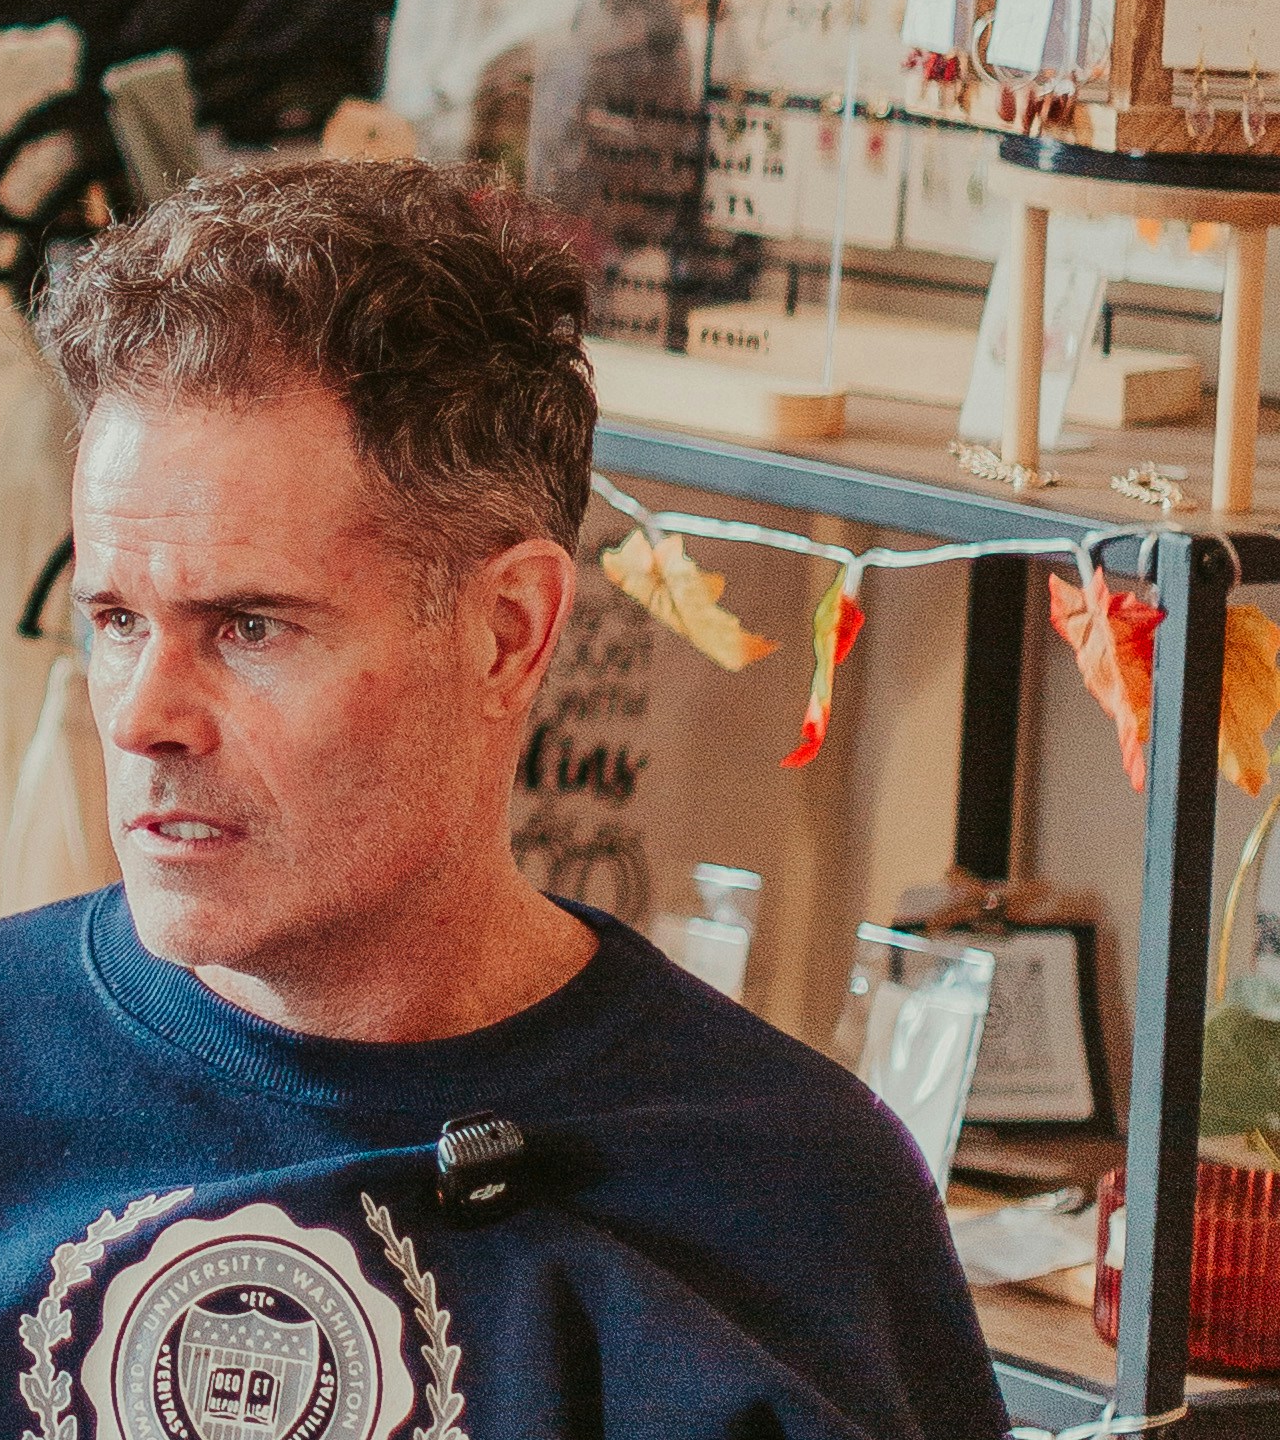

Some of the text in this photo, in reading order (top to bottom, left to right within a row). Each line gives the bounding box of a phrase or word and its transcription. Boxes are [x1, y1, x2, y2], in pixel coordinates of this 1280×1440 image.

[143, 1254, 267, 1332] UNIVERSITY
[291, 1267, 364, 1430] WASHINGTON
[156, 1355, 183, 1435] VERITAS
[252, 1378, 270, 1395] ET
